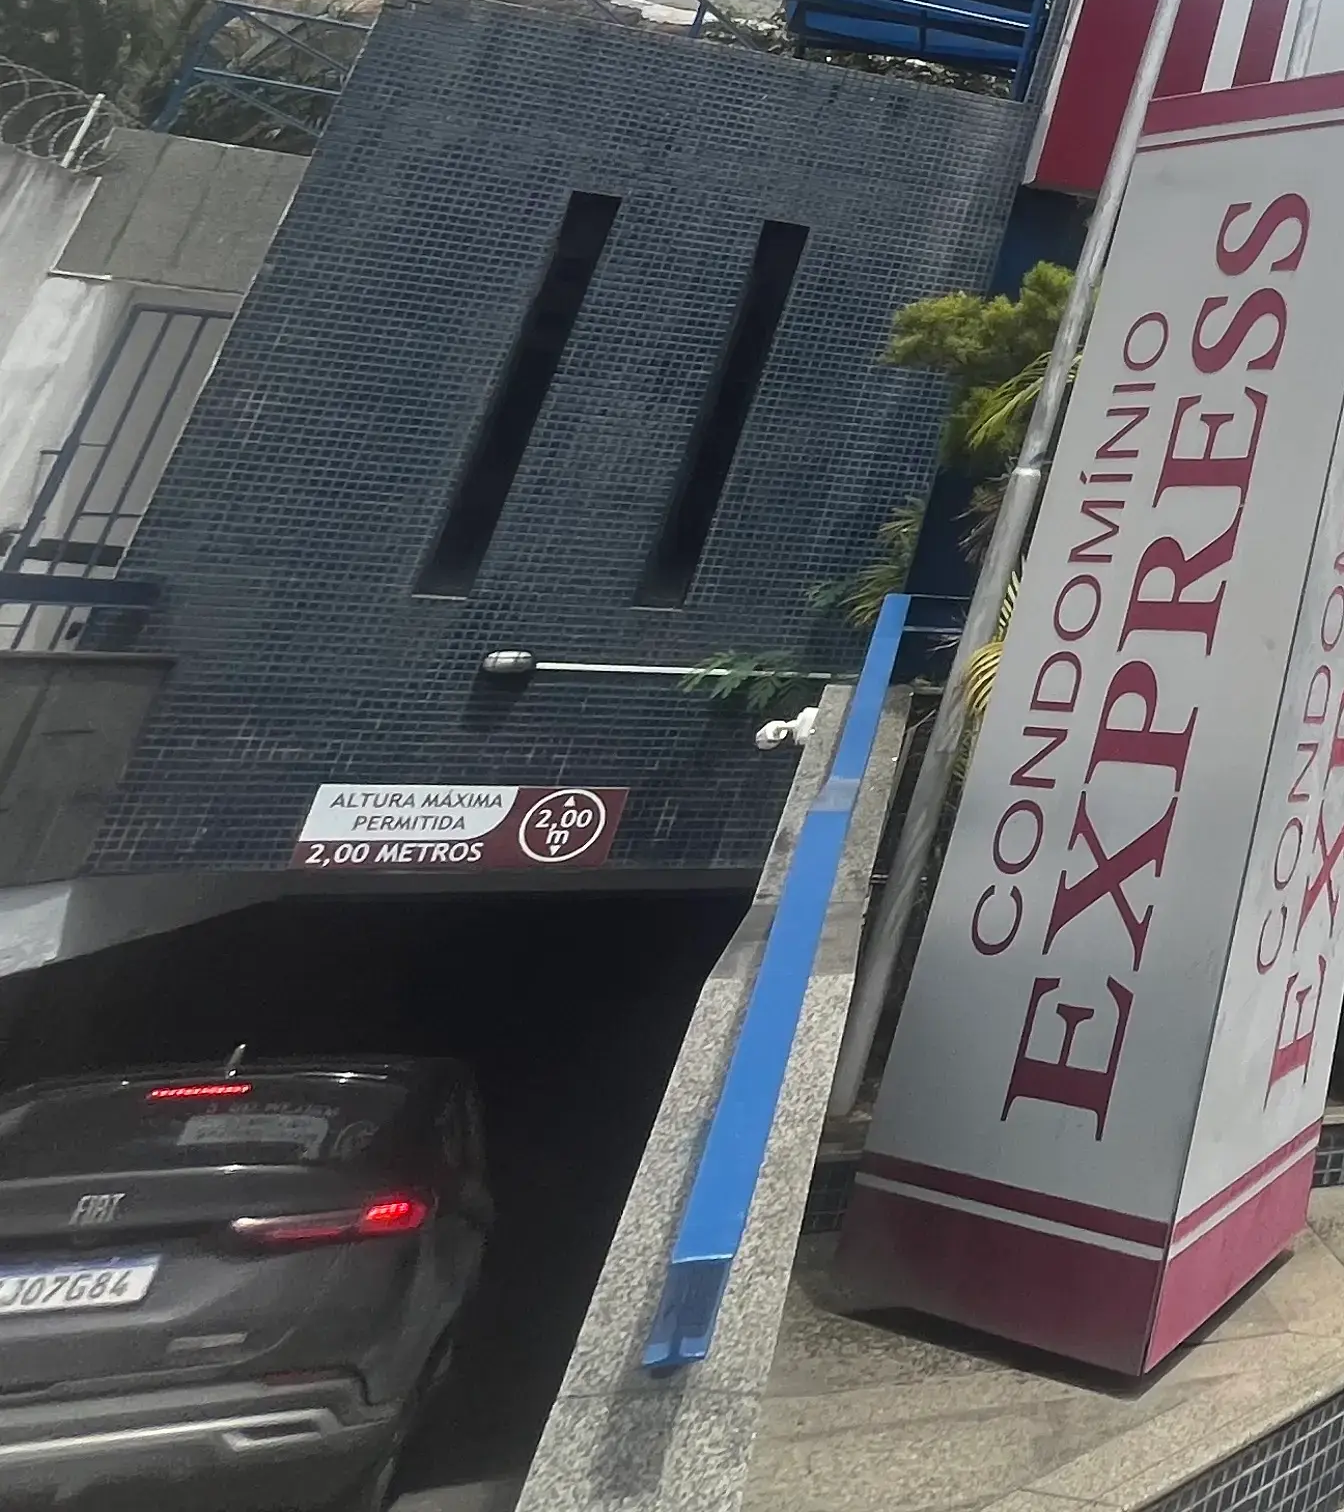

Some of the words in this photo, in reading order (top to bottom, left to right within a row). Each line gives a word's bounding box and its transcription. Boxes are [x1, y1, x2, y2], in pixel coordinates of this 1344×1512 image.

[971, 311, 1169, 956] CONDOMÍNIO
[1001, 192, 1311, 1141] EXPRESS
[329, 792, 416, 808] ALTURA
[421, 788, 503, 808] MÁXIMA
[351, 815, 466, 831] PERMITIDA
[535, 809, 593, 833] 2,00
[545, 830, 569, 845] m
[305, 843, 370, 867] 2,00
[374, 841, 484, 863] METROS
[68, 1193, 126, 1225] FIAT
